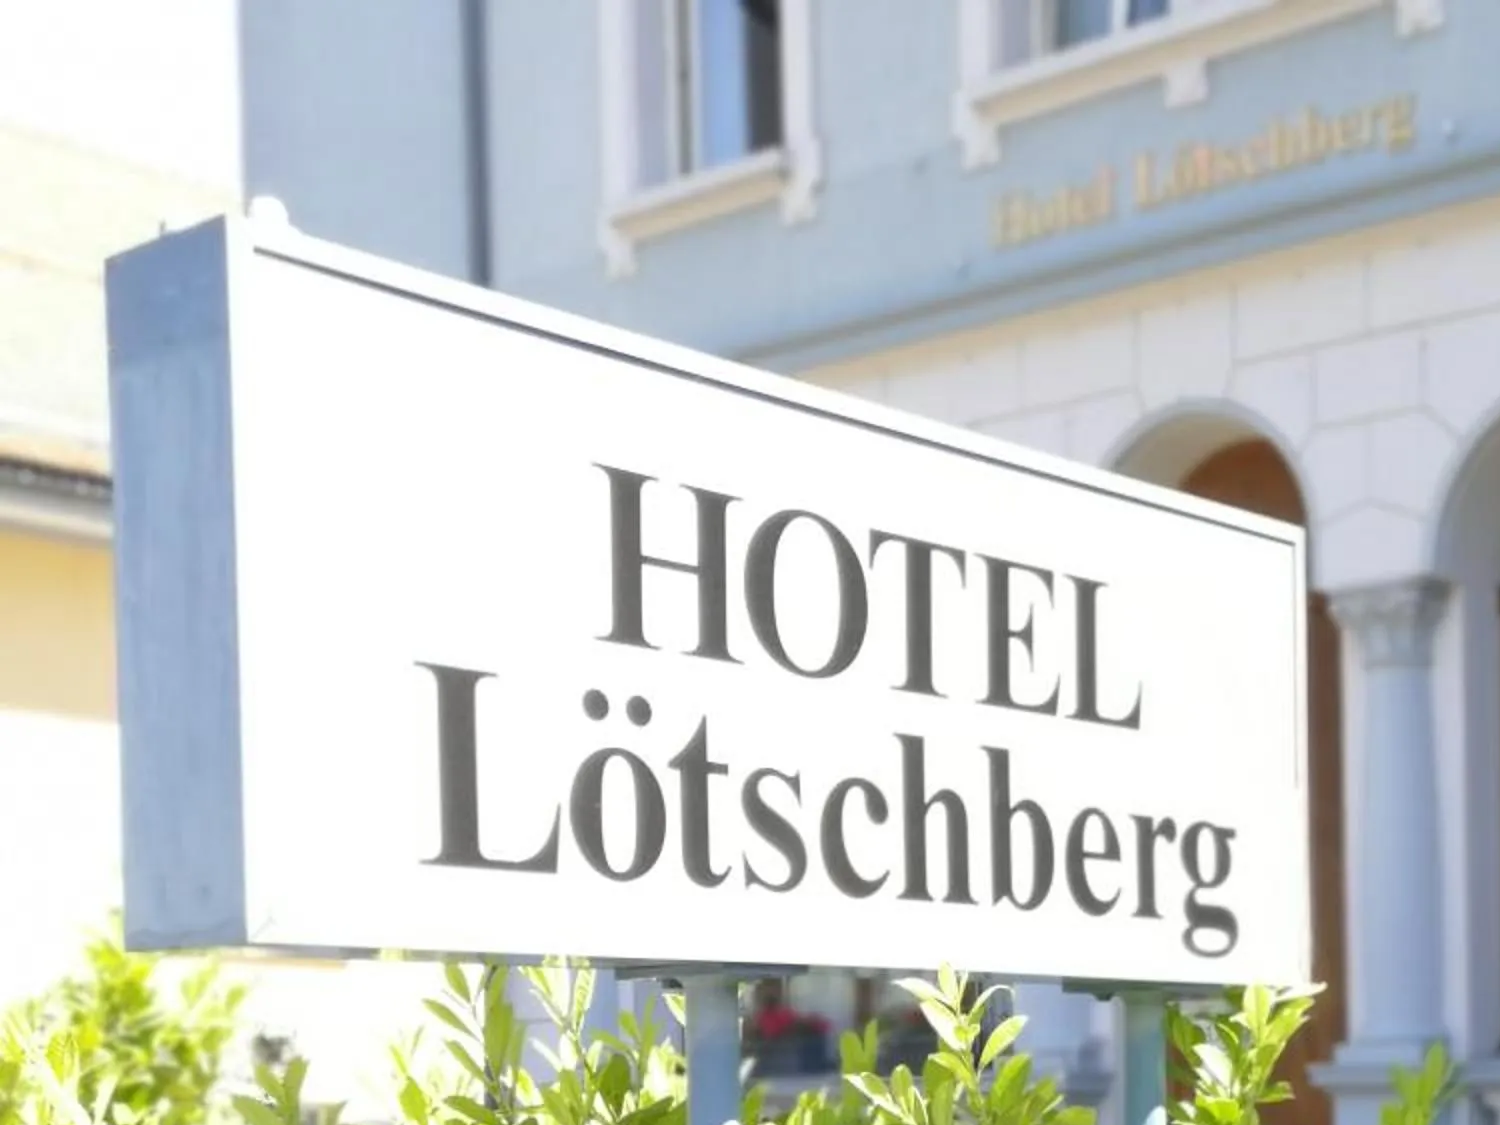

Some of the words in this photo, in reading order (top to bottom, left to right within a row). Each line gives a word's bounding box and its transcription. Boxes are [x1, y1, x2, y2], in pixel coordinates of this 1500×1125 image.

[990, 163, 1117, 248] Hotel
[592, 462, 1143, 730] HOTEL
[413, 660, 1239, 958] Lötschberg
